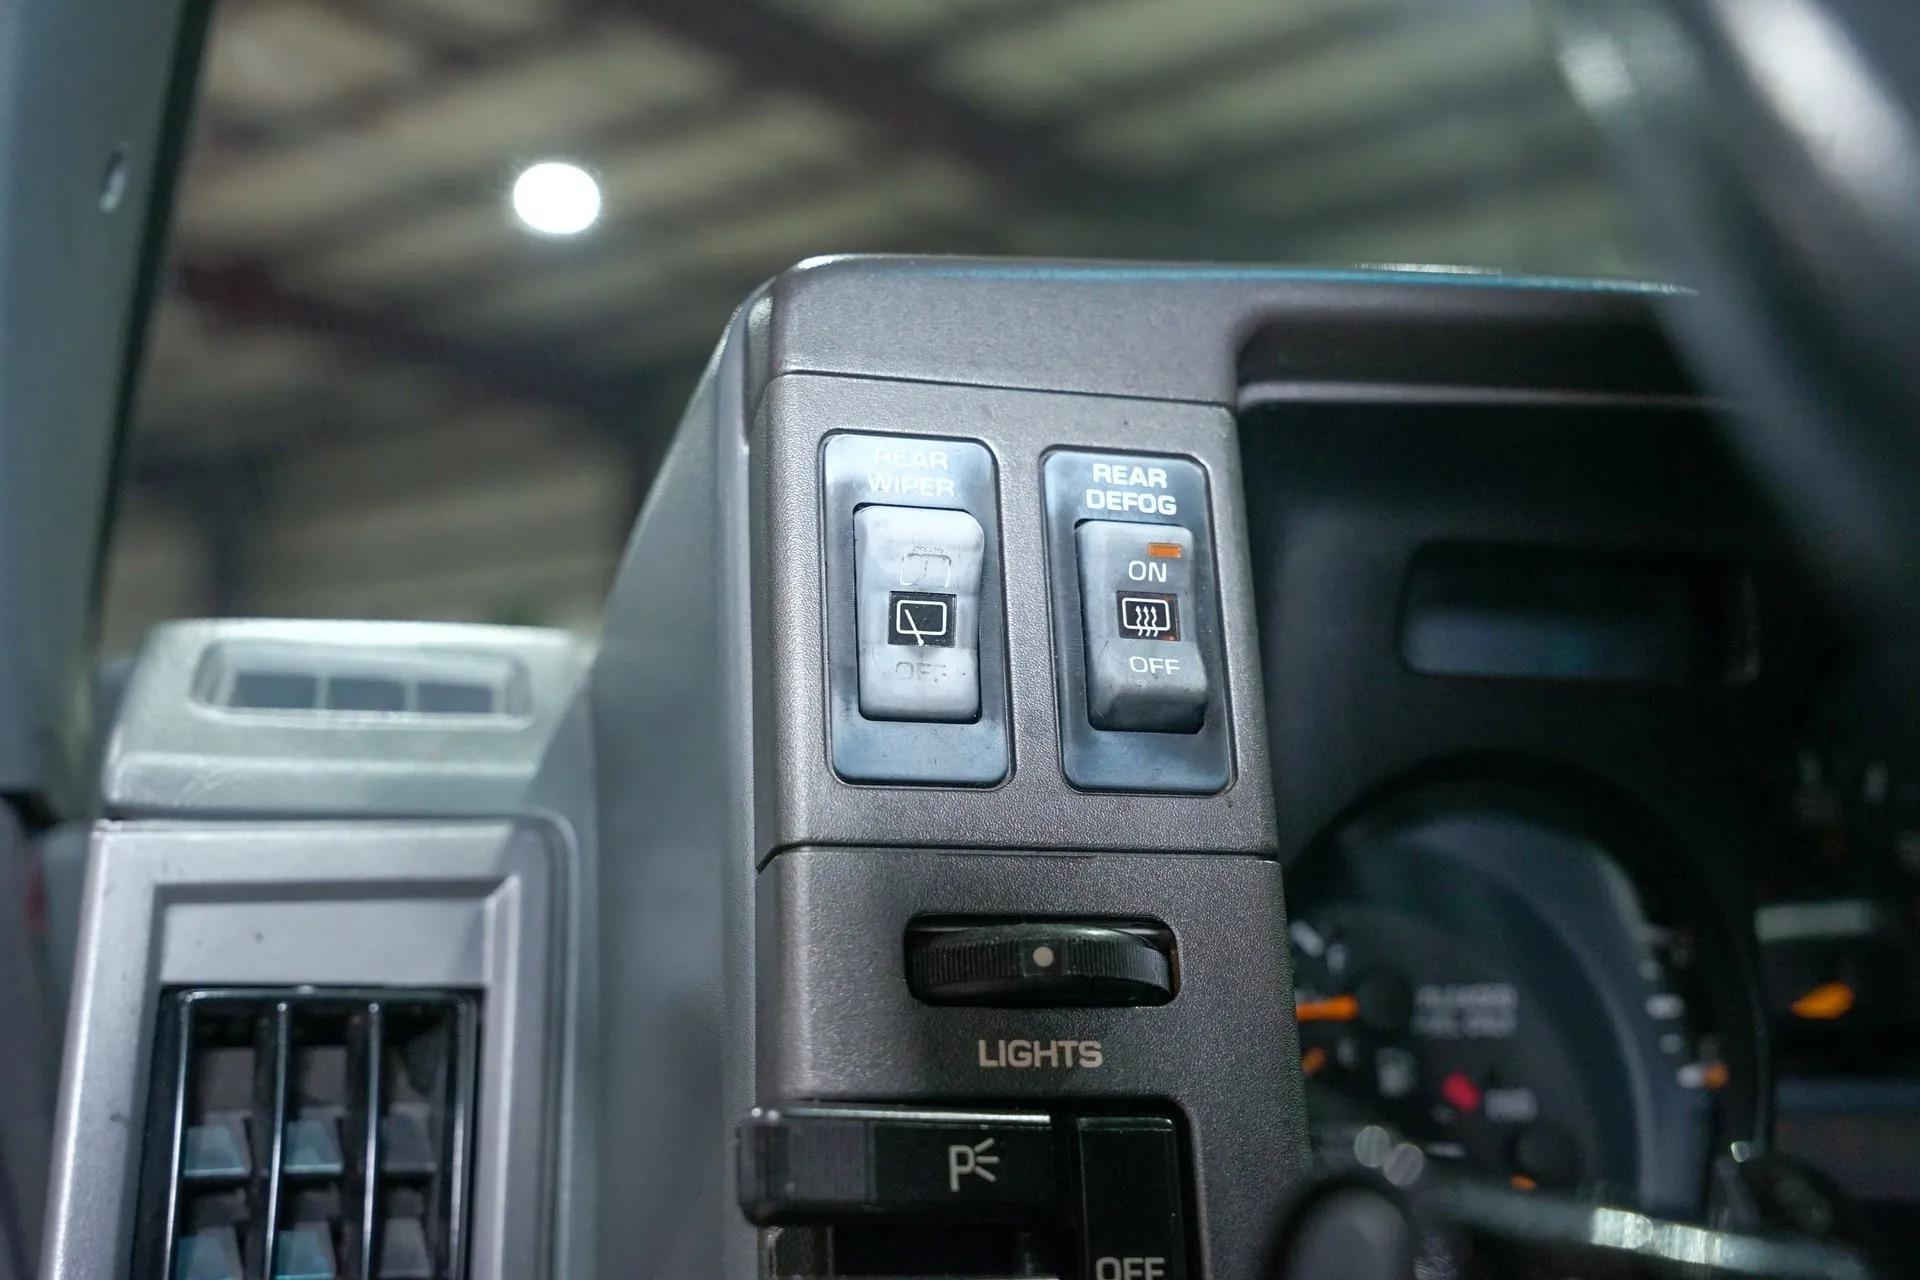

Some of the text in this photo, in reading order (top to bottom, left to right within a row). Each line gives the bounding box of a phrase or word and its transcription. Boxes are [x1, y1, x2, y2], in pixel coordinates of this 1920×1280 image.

[875, 448, 948, 470] REAR
[868, 472, 955, 497] WIPER
[1092, 463, 1168, 489] REAR
[1085, 489, 1177, 516] DEFOG
[1128, 560, 1167, 582] ON
[1129, 656, 1180, 675] OFF
[977, 1039, 1103, 1068] LIGHTS
[1095, 1257, 1166, 1280] OFF
